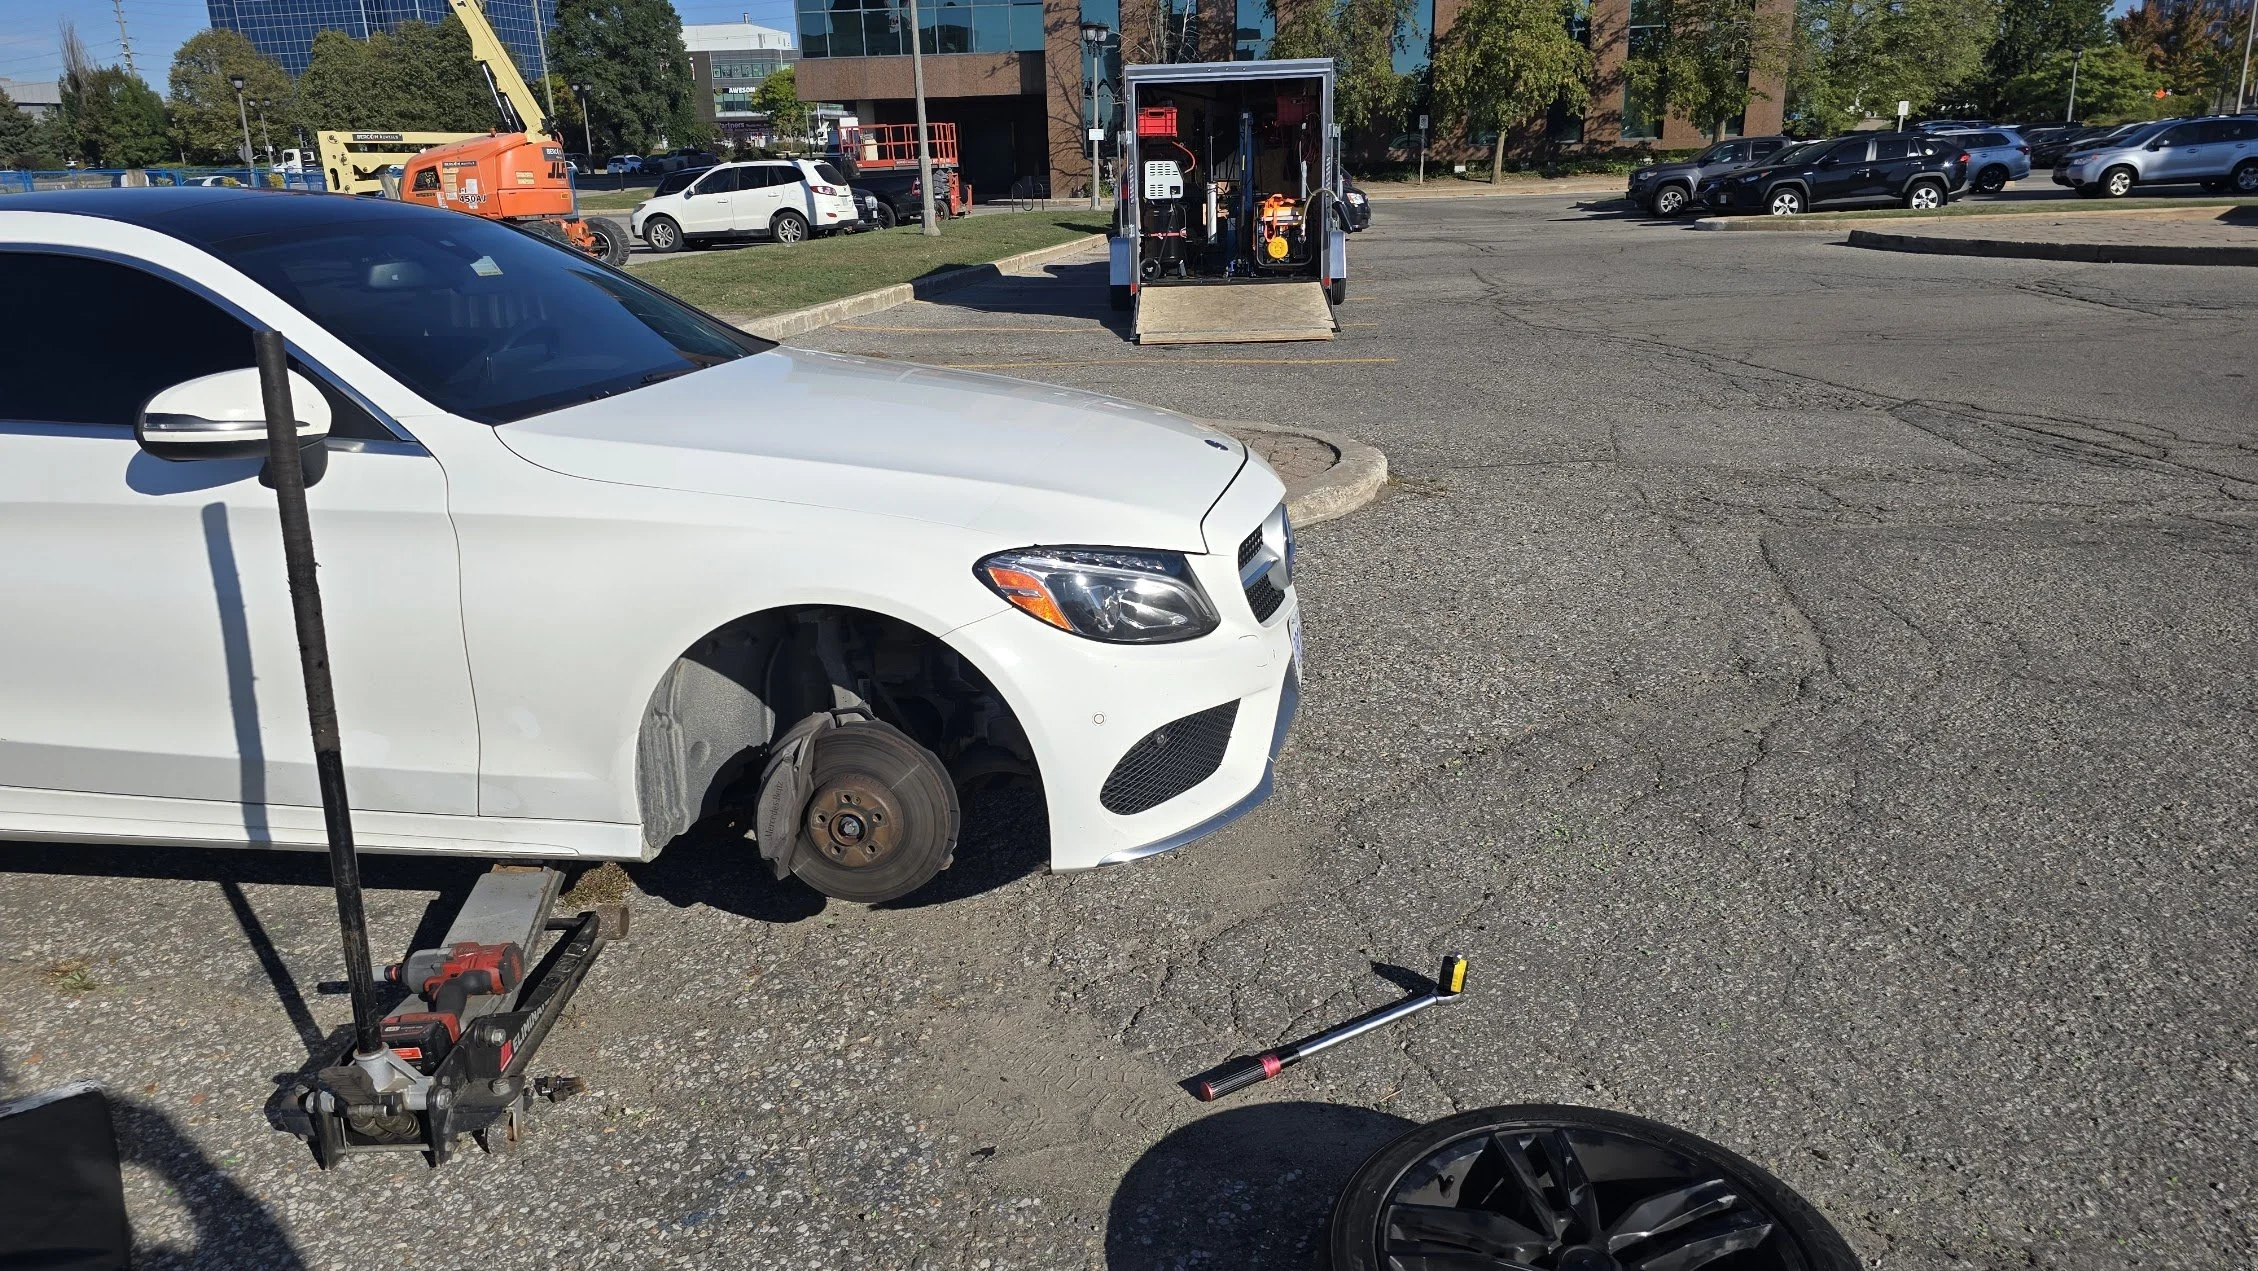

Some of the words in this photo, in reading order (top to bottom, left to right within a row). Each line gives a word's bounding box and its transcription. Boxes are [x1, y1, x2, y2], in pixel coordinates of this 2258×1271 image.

[459, 194, 487, 203] 450AJ
[765, 781, 784, 838] Mercedes-Benz
[512, 992, 555, 1055] ELIMINA
